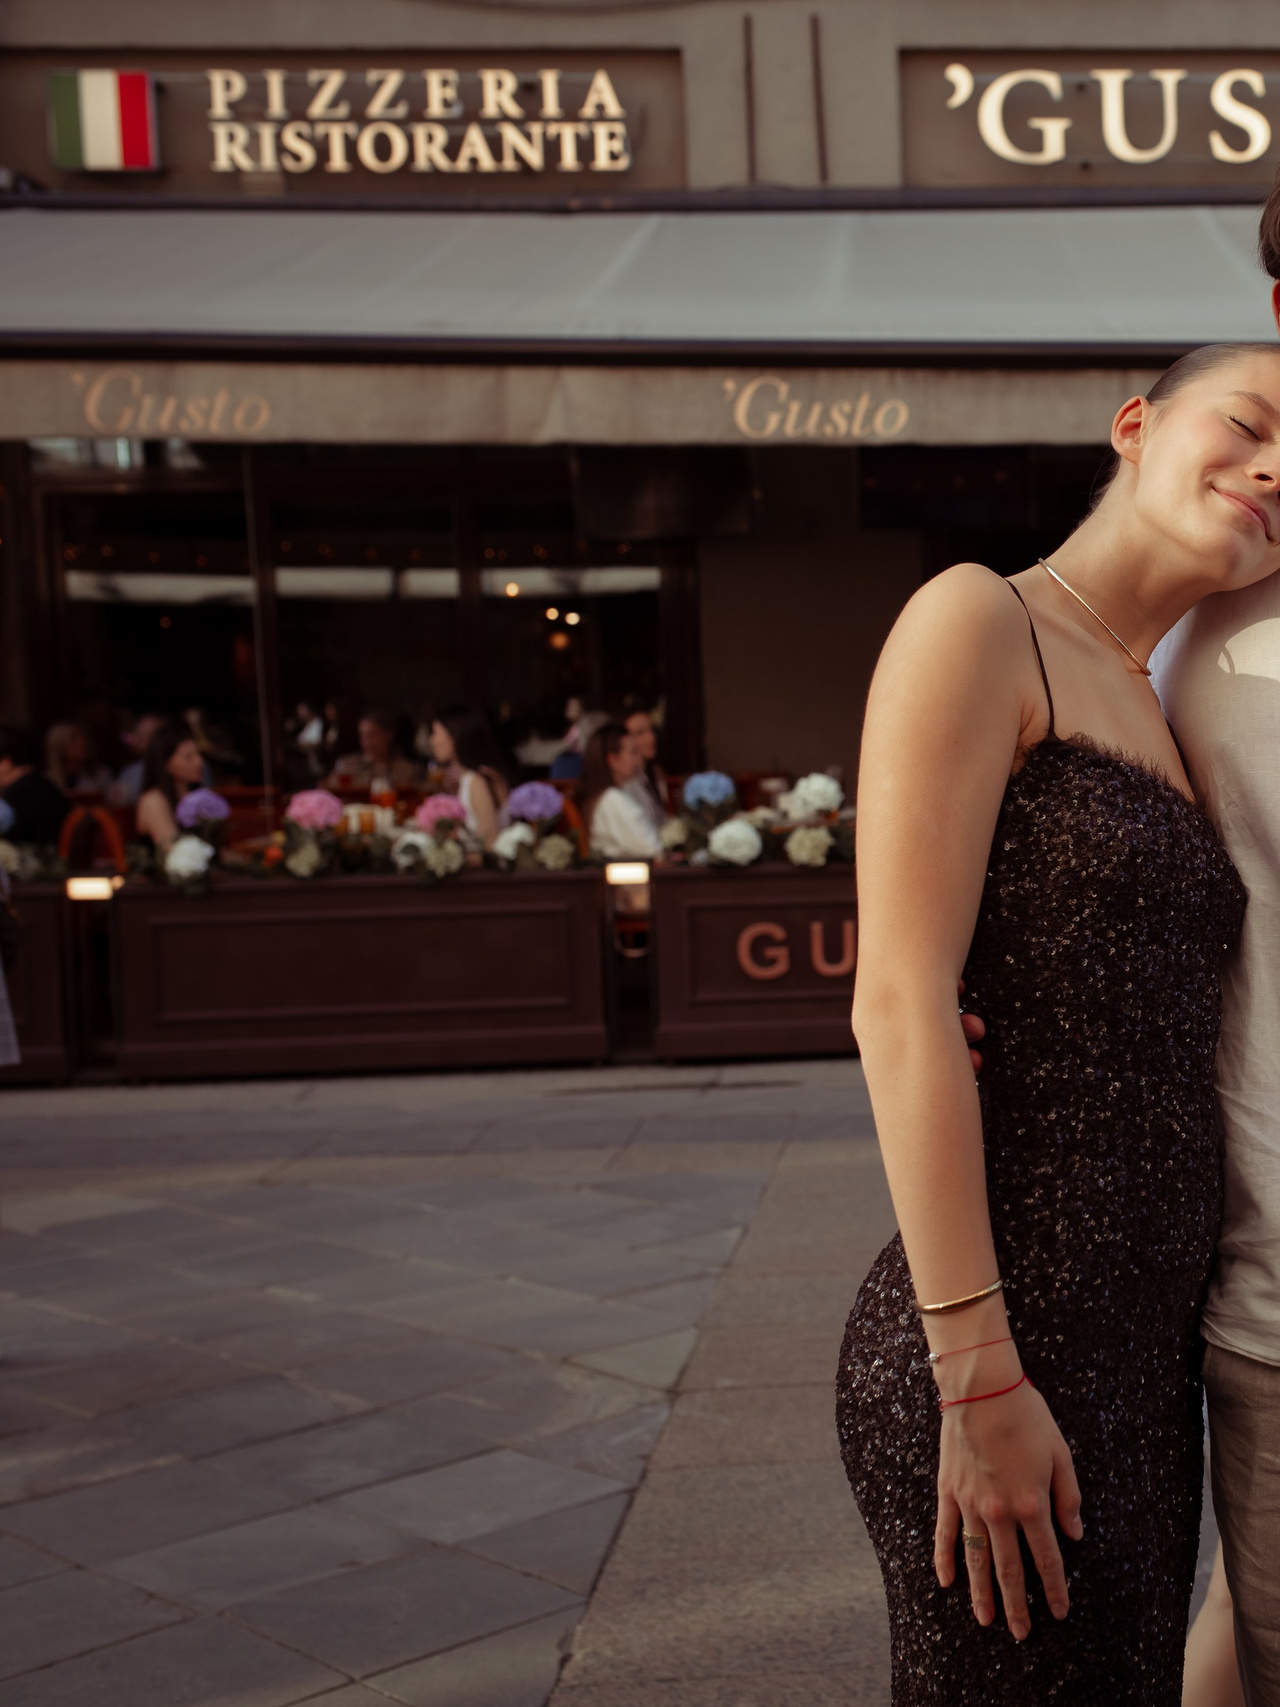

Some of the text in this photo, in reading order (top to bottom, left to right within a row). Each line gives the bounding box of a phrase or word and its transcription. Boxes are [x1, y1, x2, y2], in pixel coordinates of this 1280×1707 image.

[206, 67, 626, 120] PIZZERIA
[210, 120, 633, 174] RISTORANTE
[736, 920, 857, 981] GU
